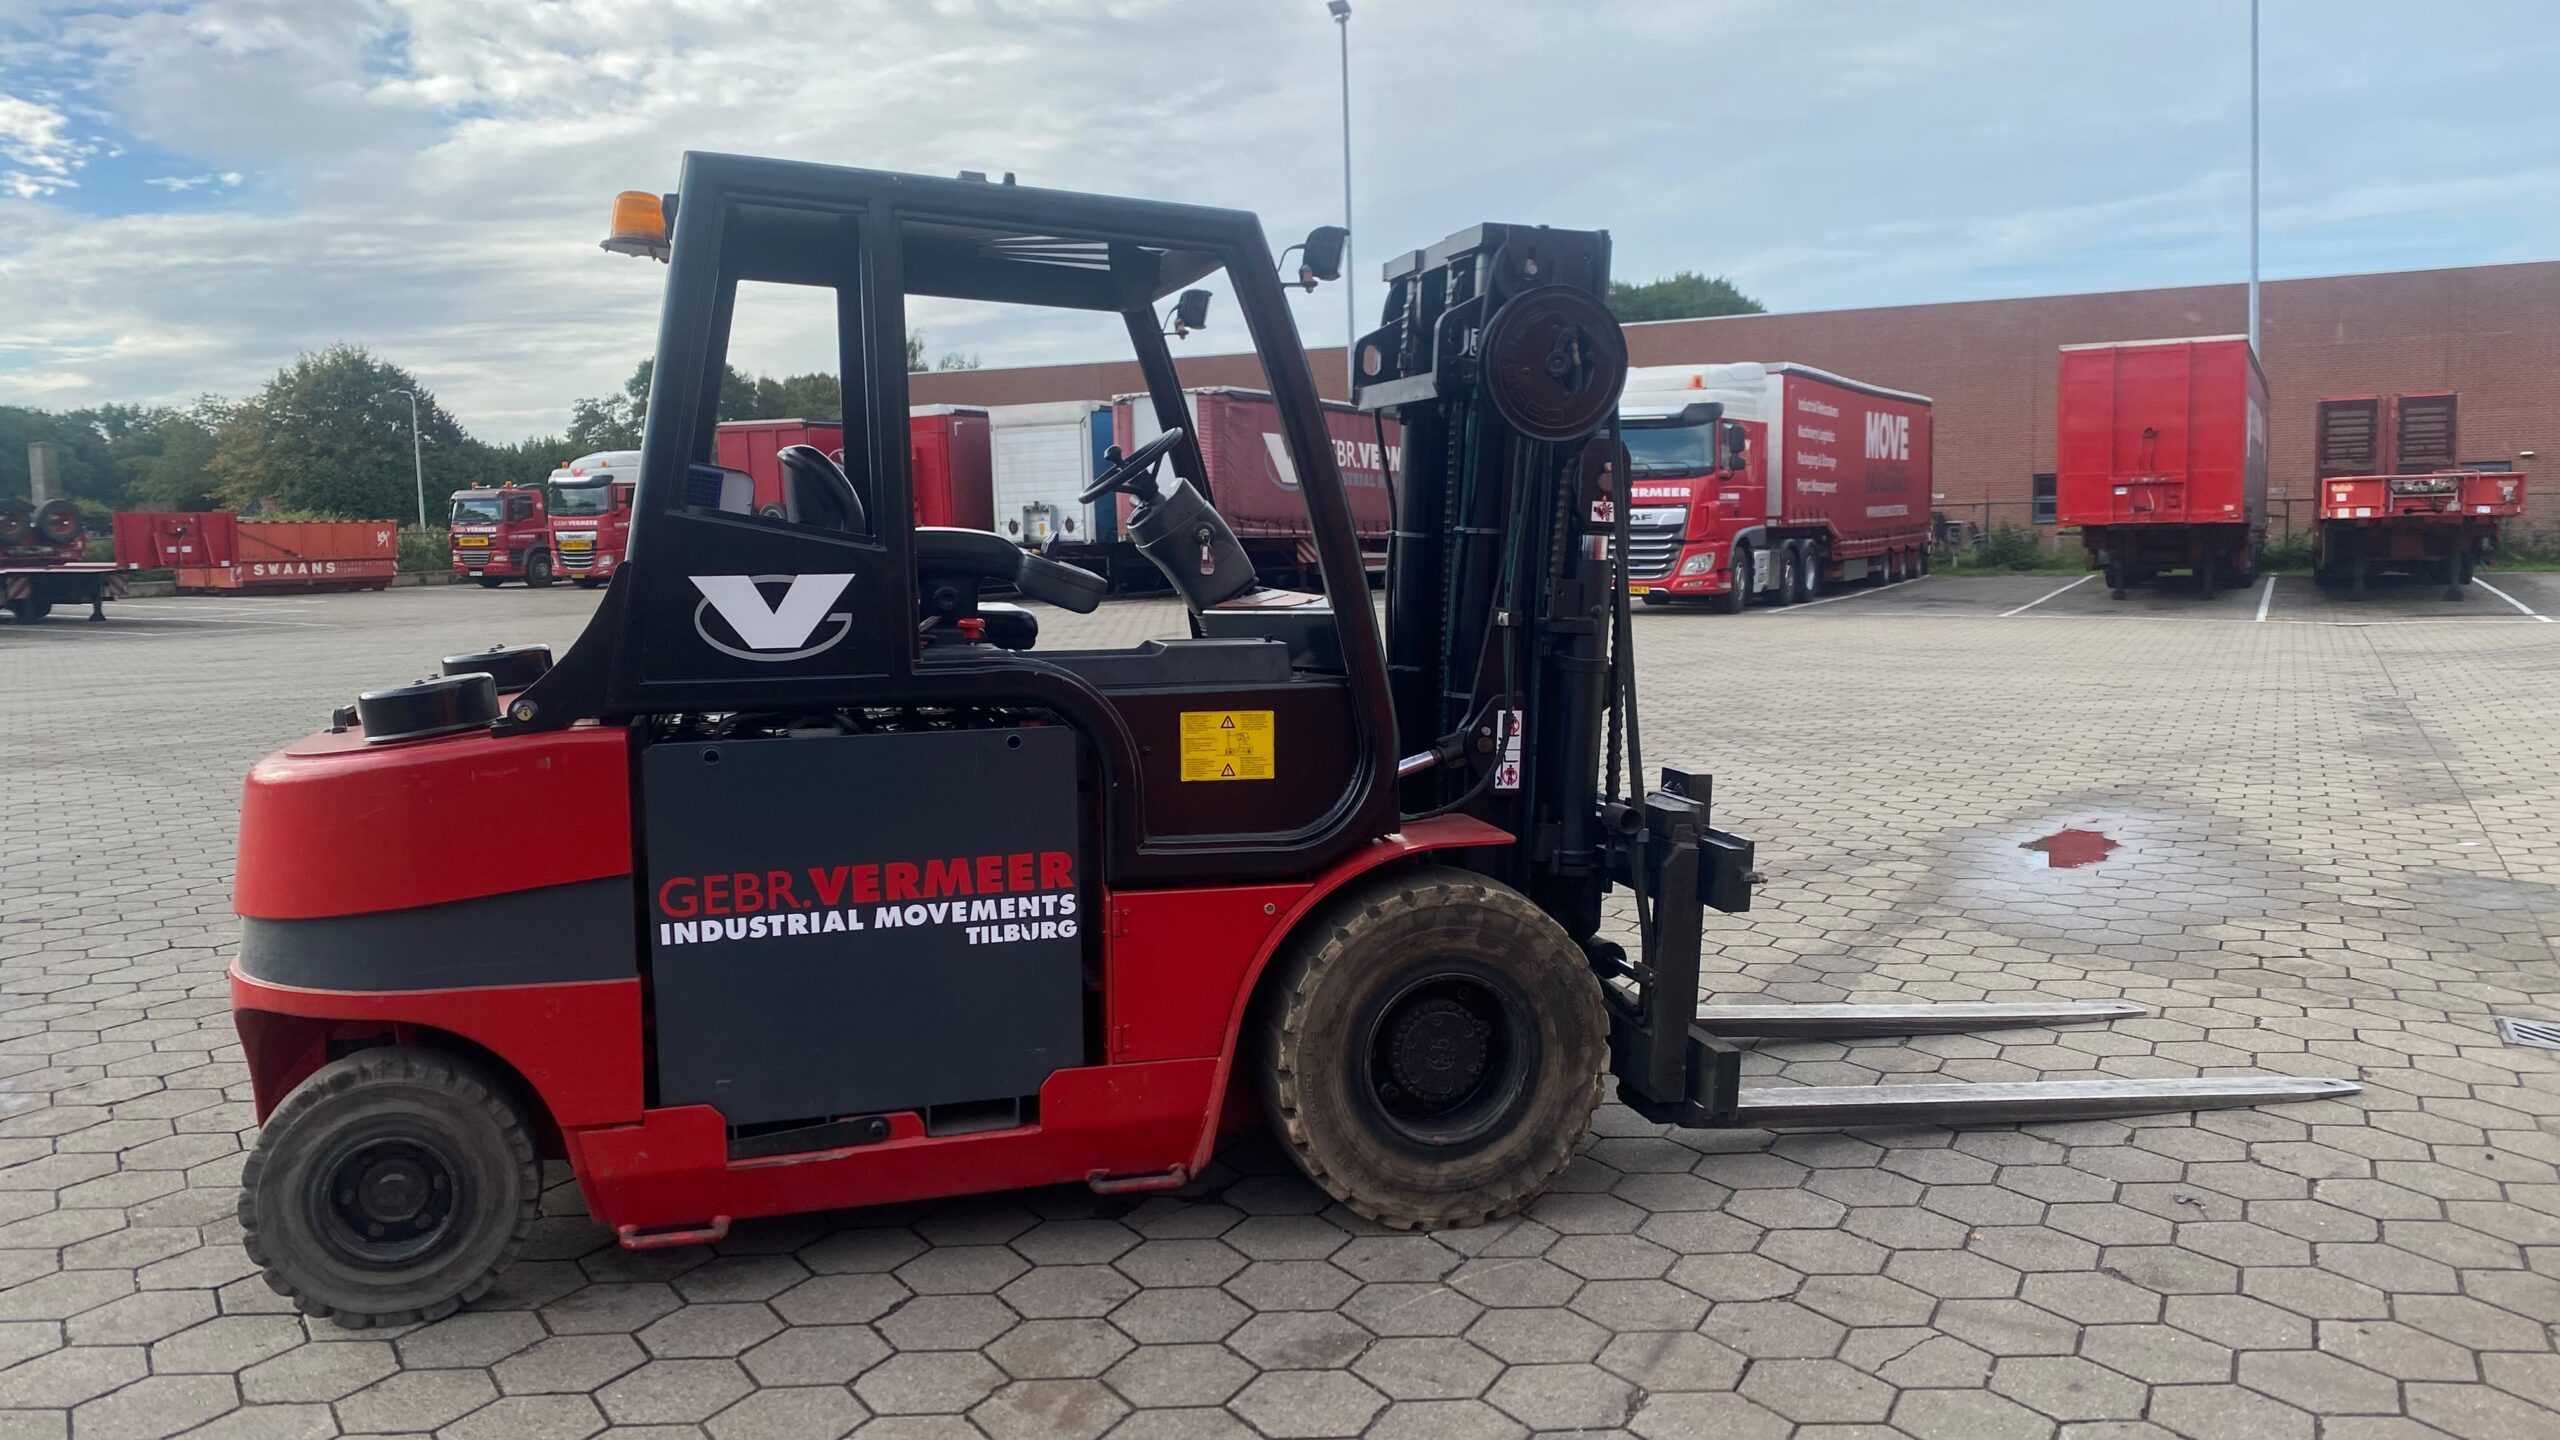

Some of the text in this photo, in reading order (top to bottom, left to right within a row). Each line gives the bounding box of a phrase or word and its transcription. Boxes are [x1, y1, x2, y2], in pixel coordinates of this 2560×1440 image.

[1865, 411, 1909, 461] MOVE
[1631, 487, 1691, 498] ERMEER
[1630, 513, 1652, 521] AF
[254, 562, 336, 576] SWAANS
[660, 894, 1076, 945] INDUSTRIAL MOVEMENTS
[966, 920, 1077, 944] TILBURG
